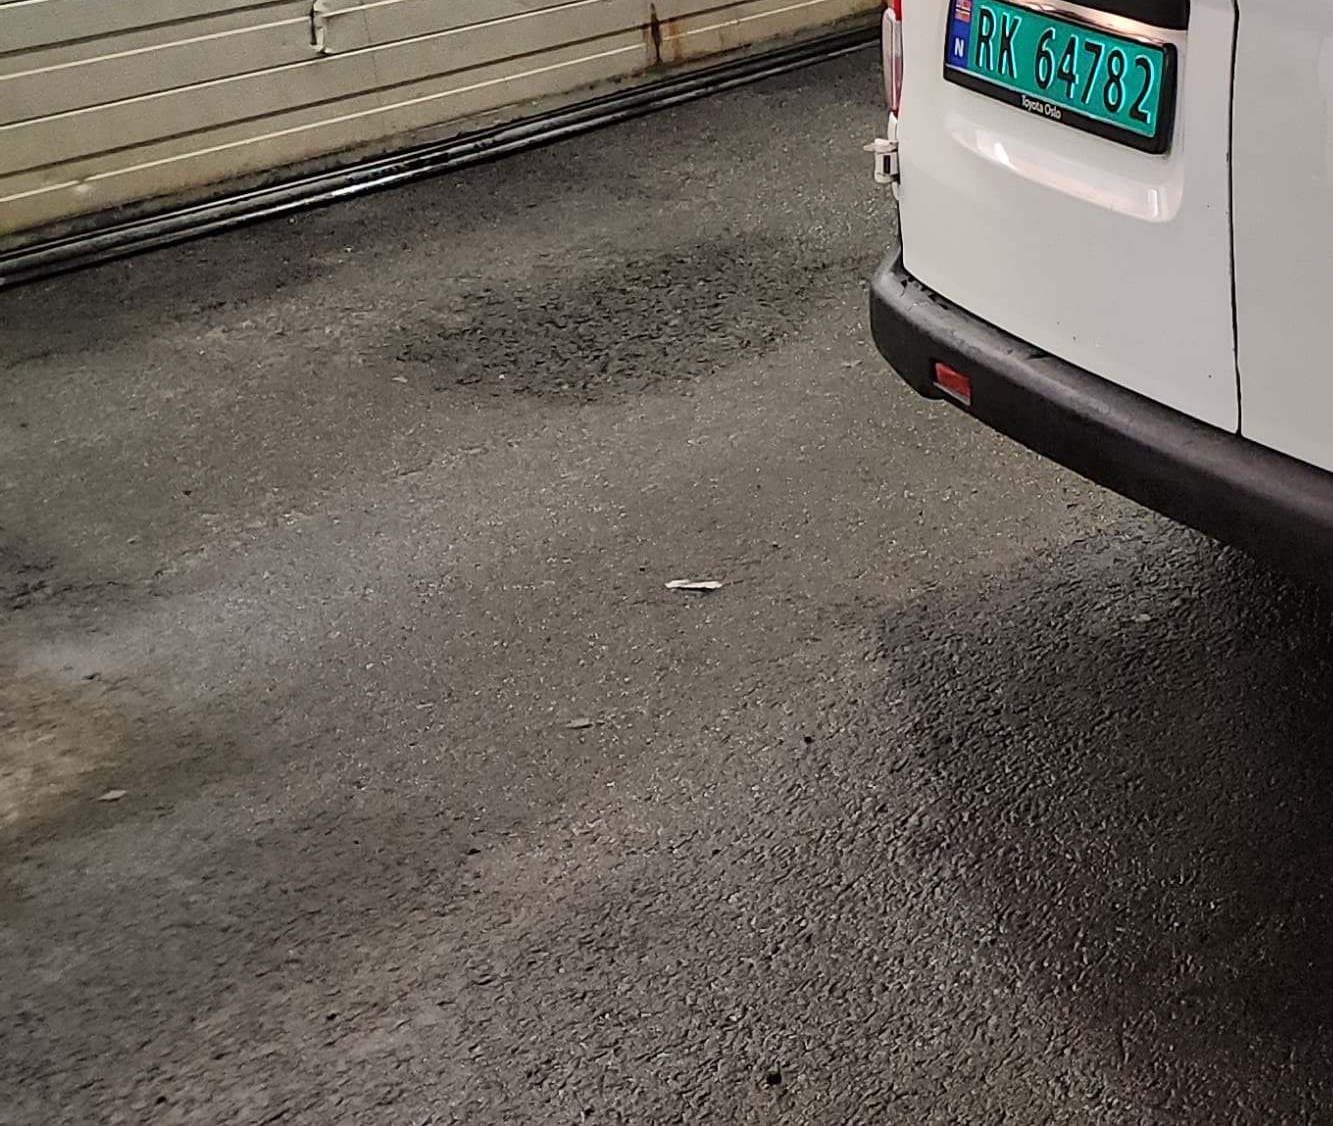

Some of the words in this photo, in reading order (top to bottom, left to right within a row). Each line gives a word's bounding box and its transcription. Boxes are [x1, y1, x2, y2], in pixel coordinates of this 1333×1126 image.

[953, 36, 965, 58] N
[974, 5, 1022, 80] RK
[1034, 27, 1155, 124] 64782
[1020, 95, 1044, 114] Toyota
[1044, 103, 1062, 120] Oslo
